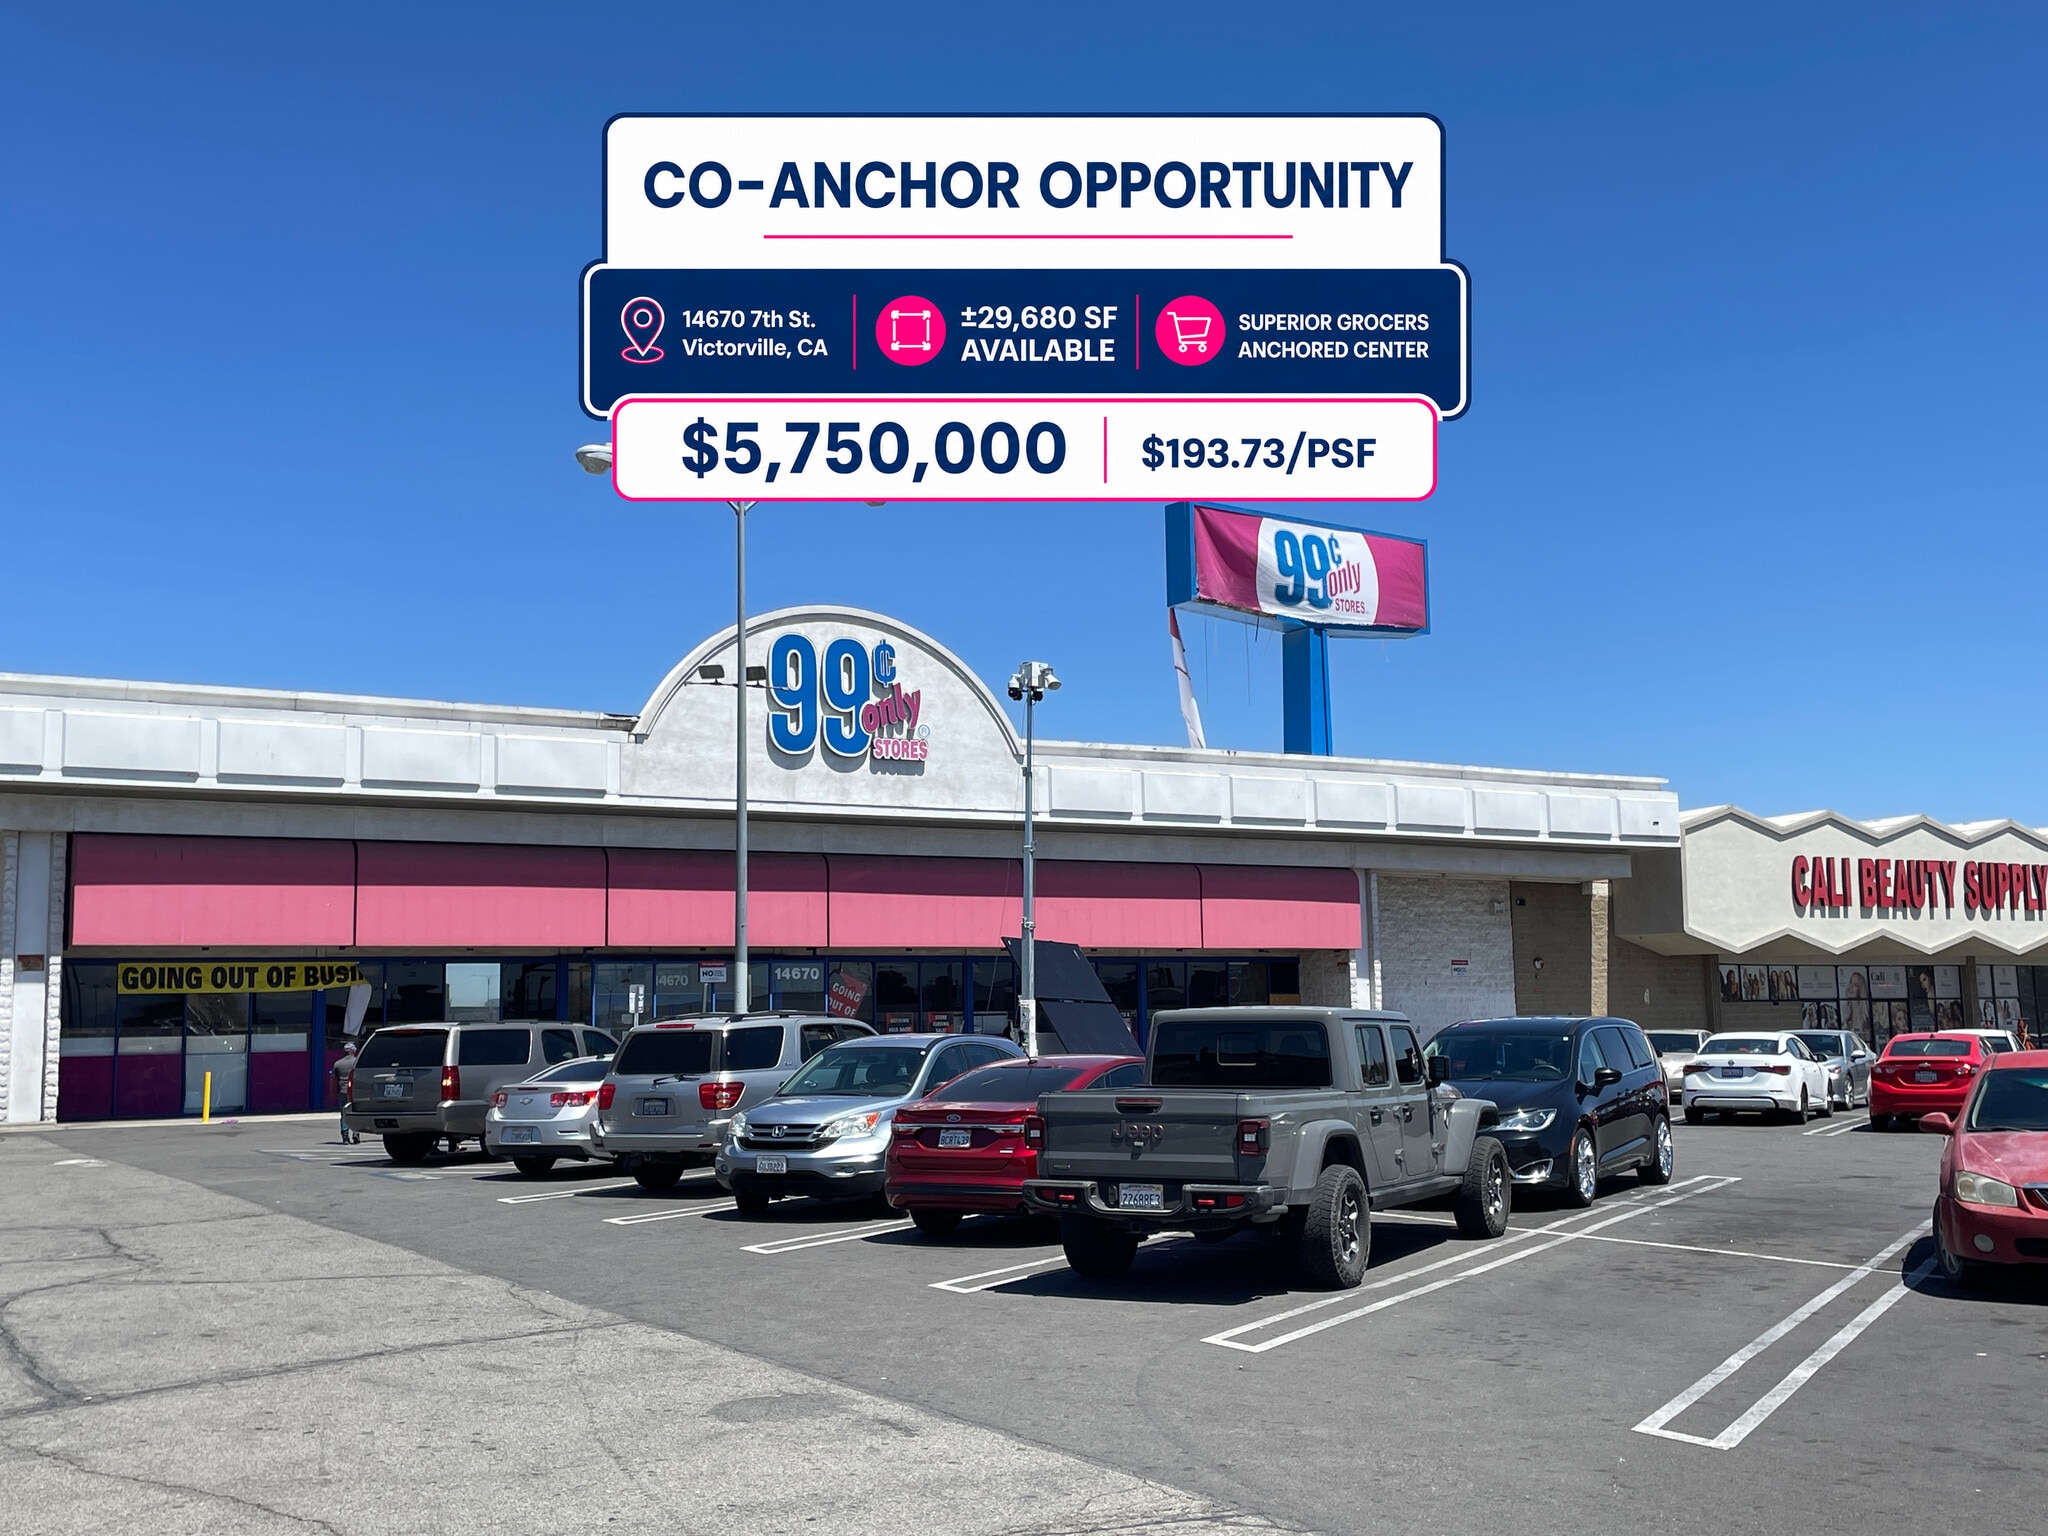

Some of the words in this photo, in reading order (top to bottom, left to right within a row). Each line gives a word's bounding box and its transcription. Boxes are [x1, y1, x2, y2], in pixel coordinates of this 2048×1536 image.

[1327, 560, 1361, 598] only
[1335, 598, 1366, 614] STORES
[862, 682, 921, 733] only
[872, 738, 928, 760] STORES
[1791, 854, 1852, 907] CALI
[1858, 858, 1957, 909] BEAUTY
[1963, 860, 2048, 911] SUPPLY
[121, 966, 203, 990] GOING
[210, 966, 259, 989] OUT
[266, 966, 296, 988] OF
[775, 967, 820, 980] 14670
[832, 982, 861, 1003] GOING
[844, 1006, 857, 1018] OF
[1112, 1119, 1165, 1142] Jeep
